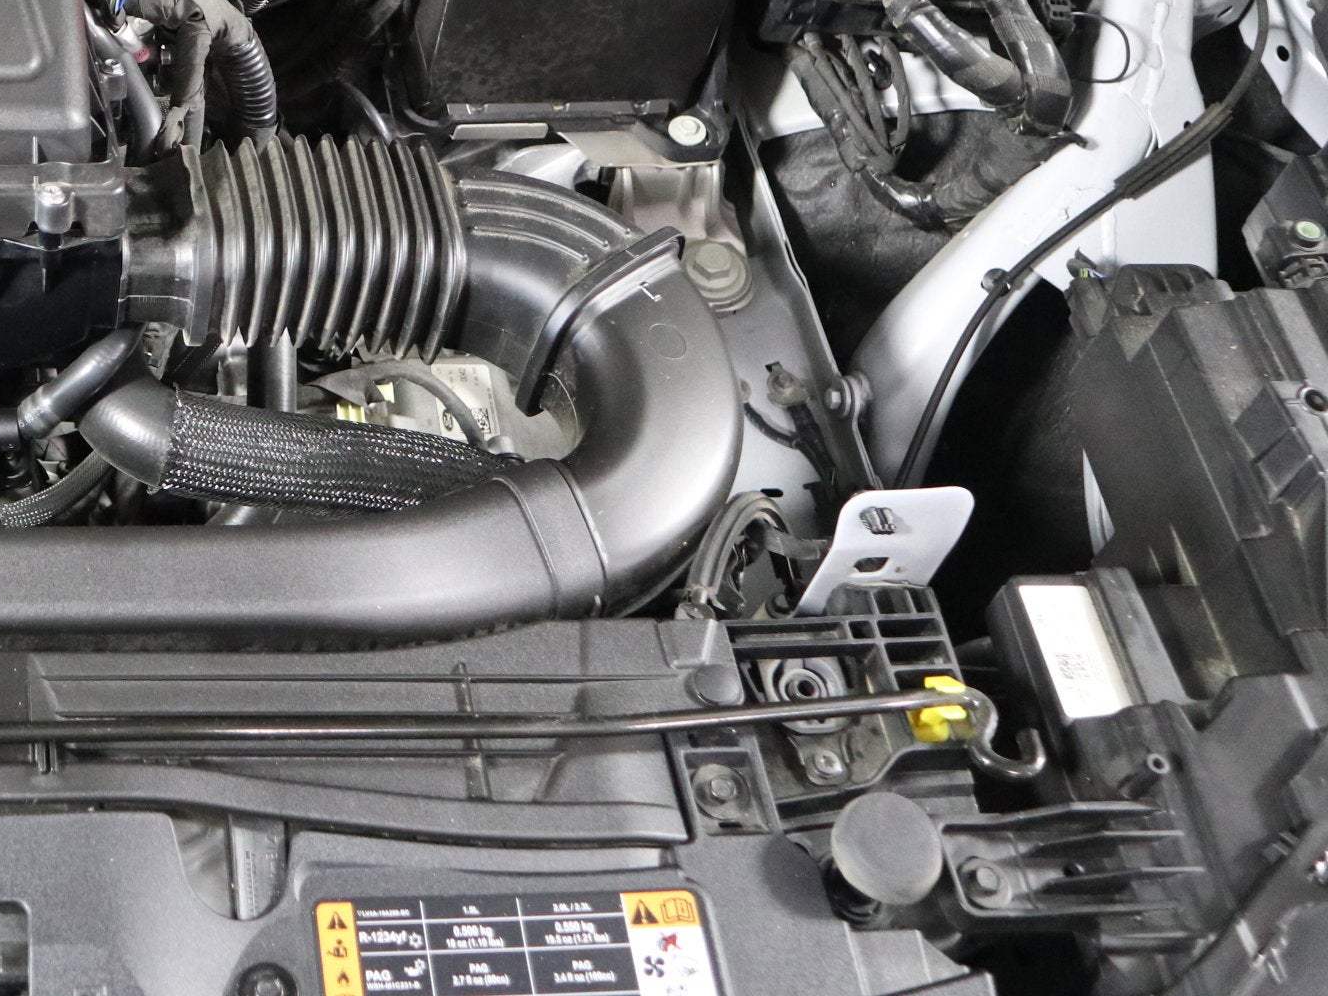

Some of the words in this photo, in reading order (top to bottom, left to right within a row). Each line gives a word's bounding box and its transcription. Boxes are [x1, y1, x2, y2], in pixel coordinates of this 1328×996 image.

[358, 930, 408, 945] R-1234yf
[469, 962, 490, 974] PAG
[572, 960, 593, 970] PAG
[366, 970, 392, 982] PAG
